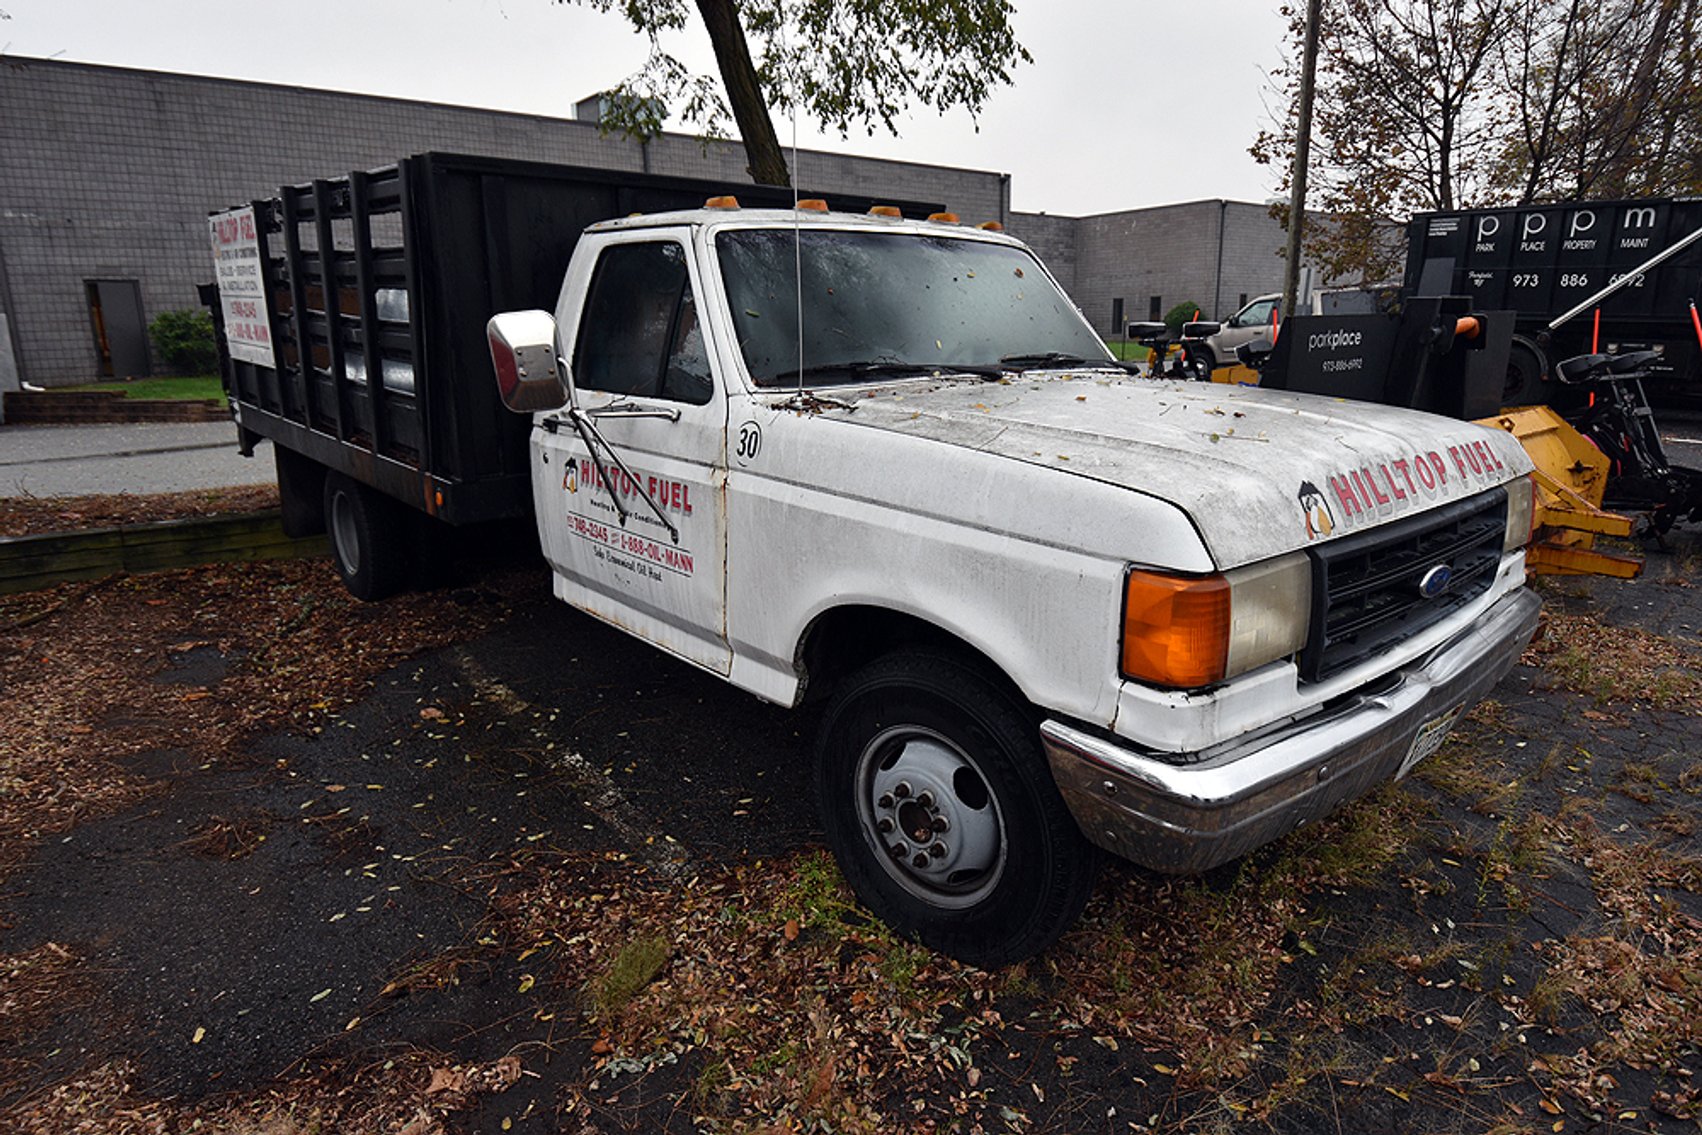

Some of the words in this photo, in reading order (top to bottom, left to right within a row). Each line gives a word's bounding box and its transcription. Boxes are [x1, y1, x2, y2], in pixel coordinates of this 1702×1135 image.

[1475, 243, 1495, 252] PARK
[1520, 241, 1546, 251] PLACE
[1562, 240, 1597, 250] PROPERTY
[1620, 238, 1649, 248] MAINT
[1513, 274, 1540, 287] 973
[1560, 274, 1588, 287] 886
[1308, 328, 1362, 352] parkplace
[736, 427, 759, 459] 30
[1329, 451, 1447, 516] HILLTOP
[1449, 440, 1504, 480] FUEL
[648, 476, 692, 513] FUEL
[634, 512, 670, 531] Conditionin
